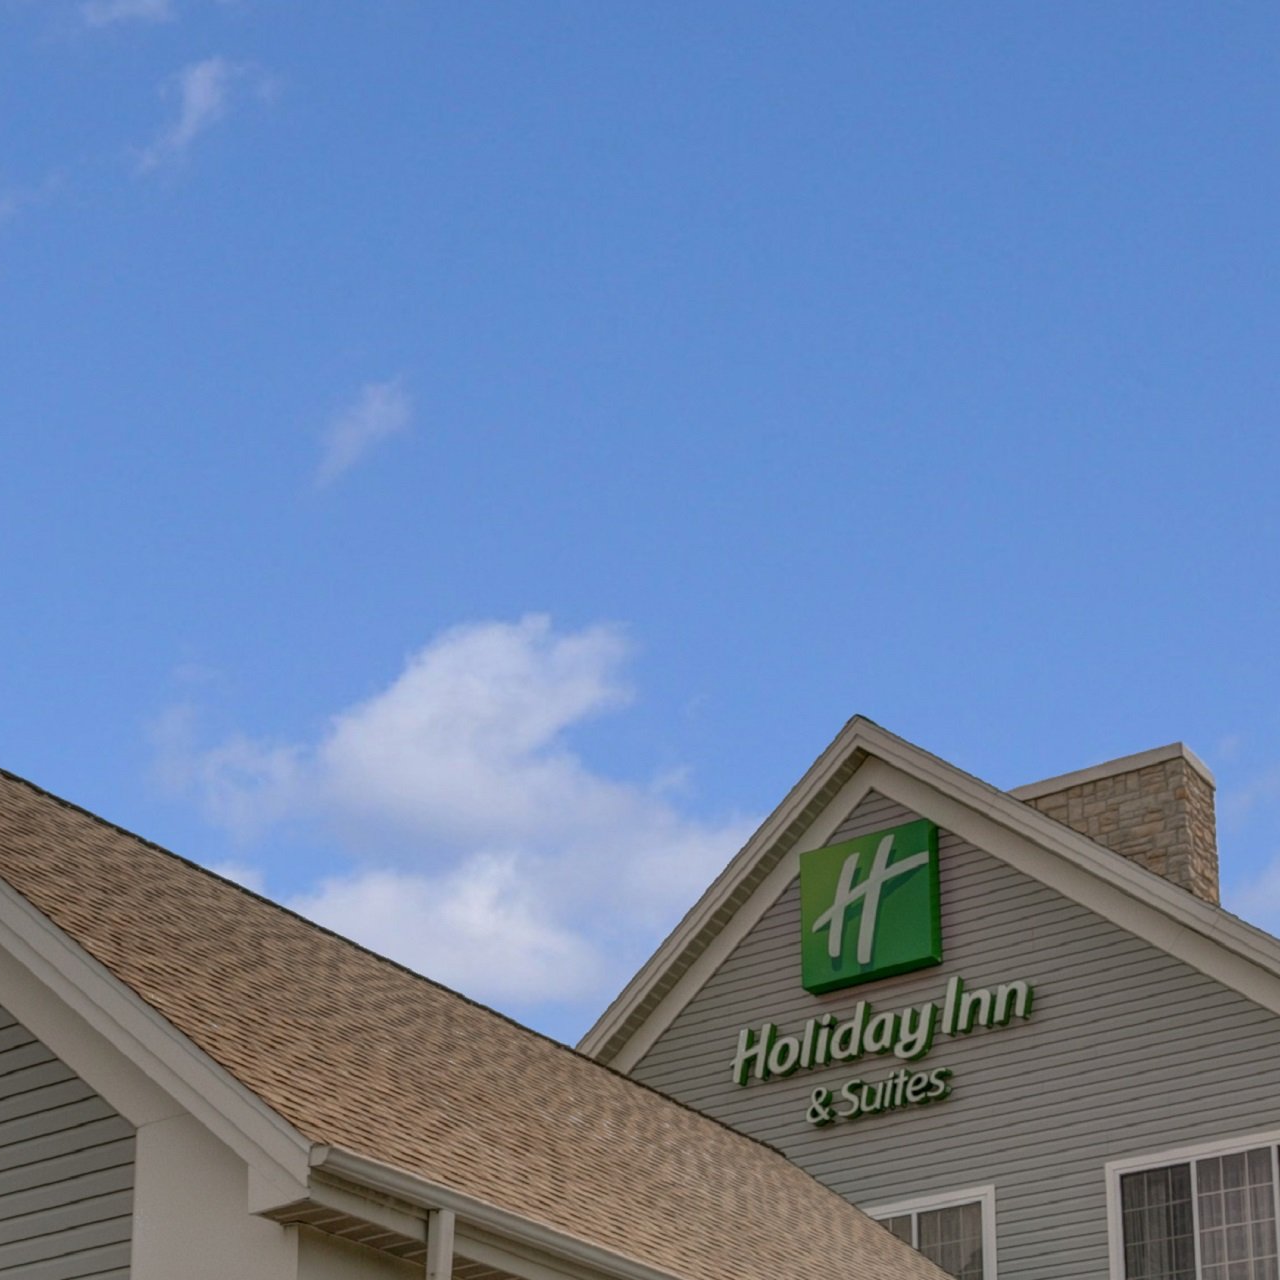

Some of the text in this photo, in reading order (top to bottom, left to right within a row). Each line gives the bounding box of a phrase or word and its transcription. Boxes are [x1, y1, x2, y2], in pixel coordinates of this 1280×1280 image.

[812, 834, 929, 964] H
[730, 976, 1033, 1085] Holiday Inn
[806, 1067, 952, 1126] & Suites
